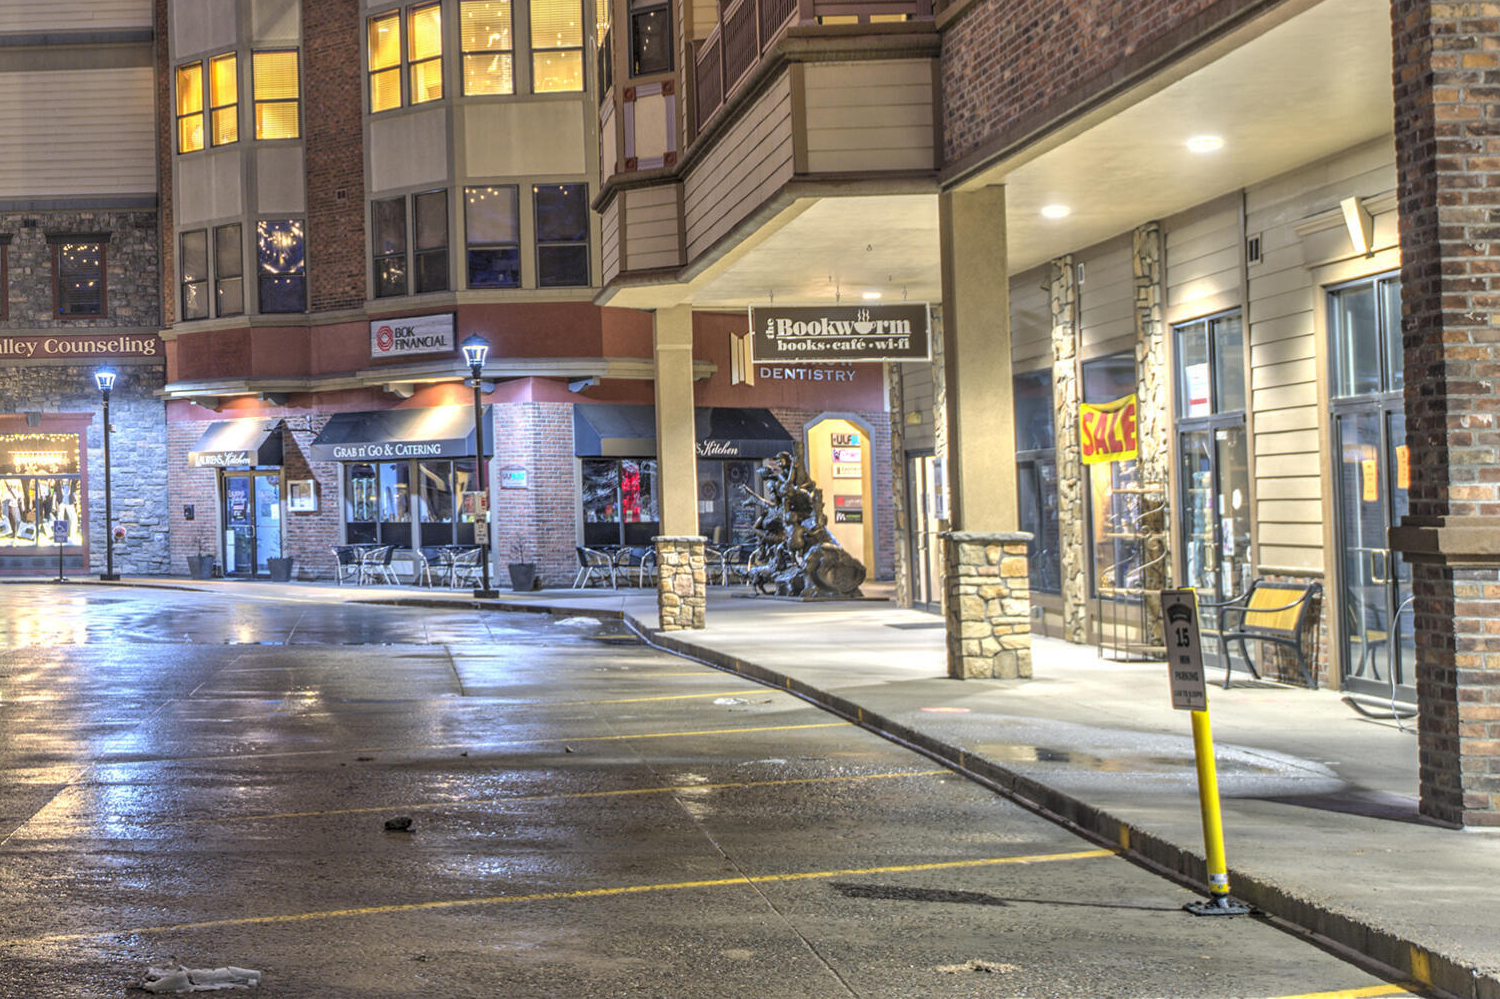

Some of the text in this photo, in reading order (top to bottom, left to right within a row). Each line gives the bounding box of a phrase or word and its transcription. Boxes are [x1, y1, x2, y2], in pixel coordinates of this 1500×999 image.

[395, 326, 415, 338] BOK
[43, 336, 156, 355] Counseling
[395, 335, 448, 350] FINANCIAL
[777, 339, 827, 351] books
[760, 367, 856, 382] DENTISTRY
[1082, 403, 1136, 456] SALE
[333, 446, 357, 458] GRAB
[368, 444, 382, 457] GO
[384, 443, 393, 456] &
[395, 443, 441, 456] CATERING
[701, 440, 738, 456] Kitchen
[1176, 627, 1190, 648] 15
[1174, 671, 1199, 682] PARKING
